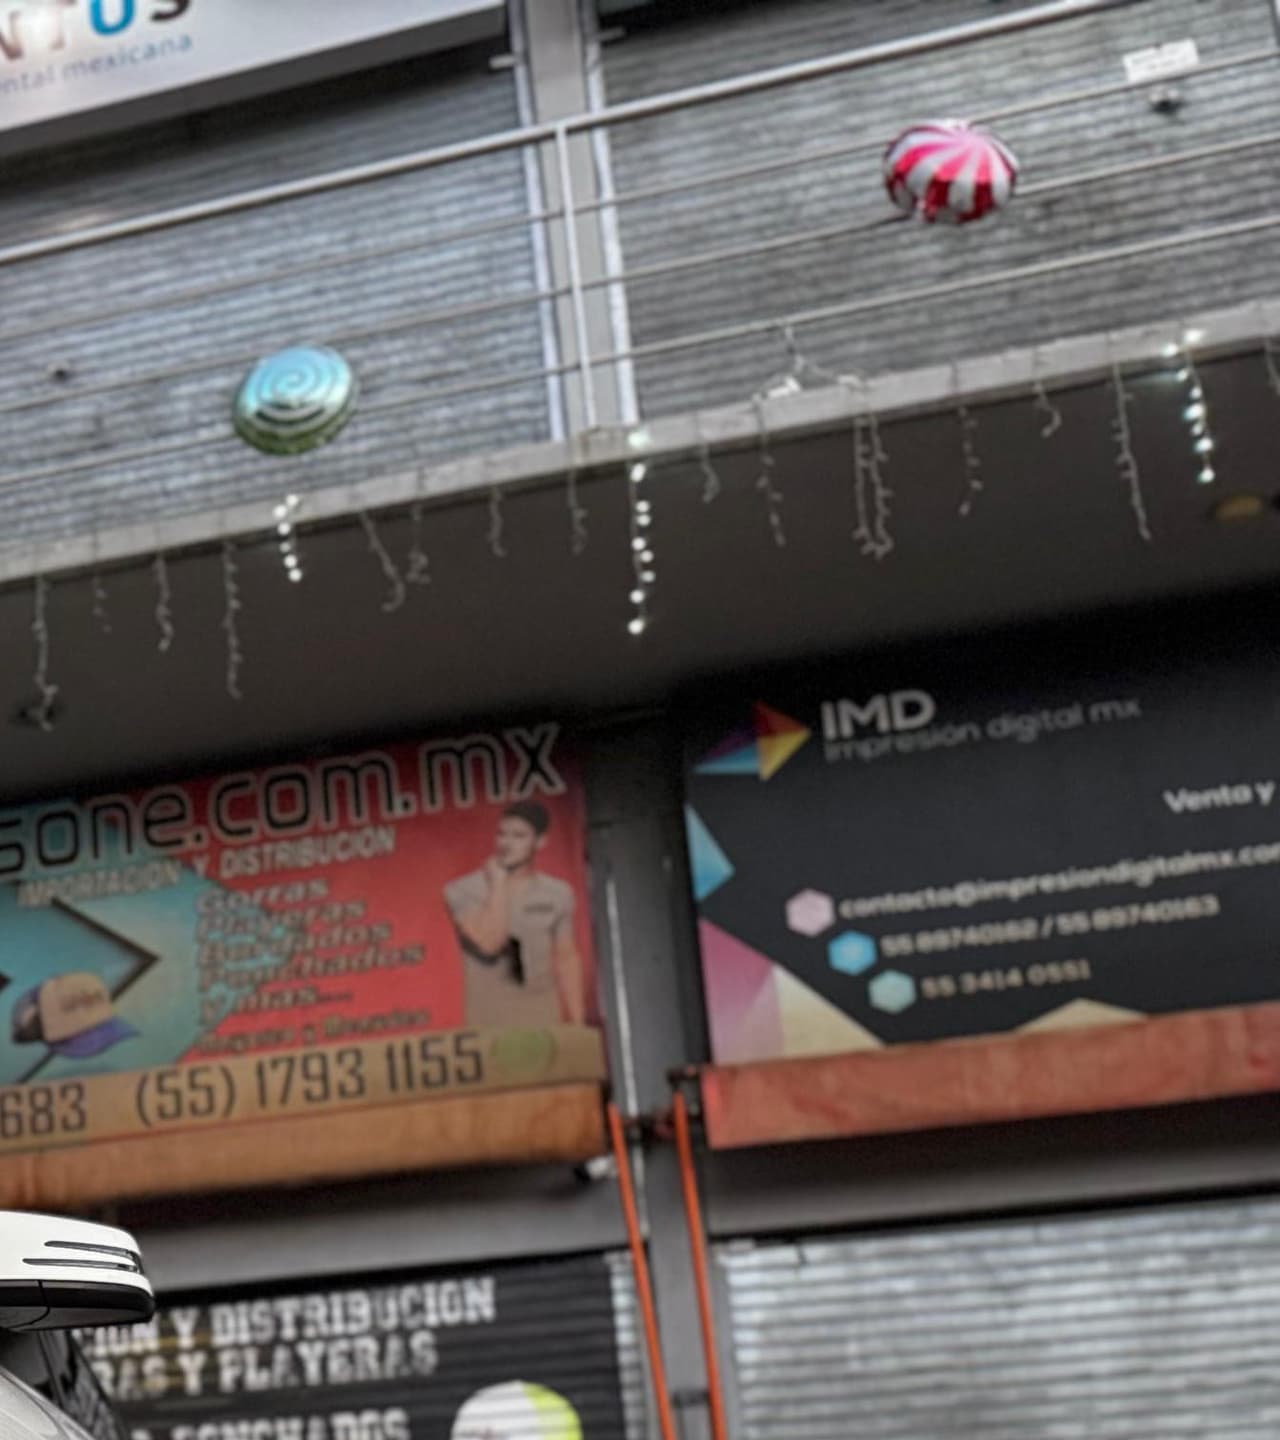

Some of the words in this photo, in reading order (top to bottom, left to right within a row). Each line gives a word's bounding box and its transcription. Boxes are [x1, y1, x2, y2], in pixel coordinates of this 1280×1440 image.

[61, 34, 193, 81] mexicana
[821, 690, 936, 740] IMD
[987, 703, 1084, 744] digital
[1163, 784, 1253, 814] Venta
[134, 1068, 238, 1128] (55)
[254, 1053, 368, 1110] 1793
[385, 1033, 485, 1092] 1155
[169, 1306, 200, 1351] Y
[210, 1276, 497, 1347] DISTRIBUCION
[176, 1349, 207, 1394] Y
